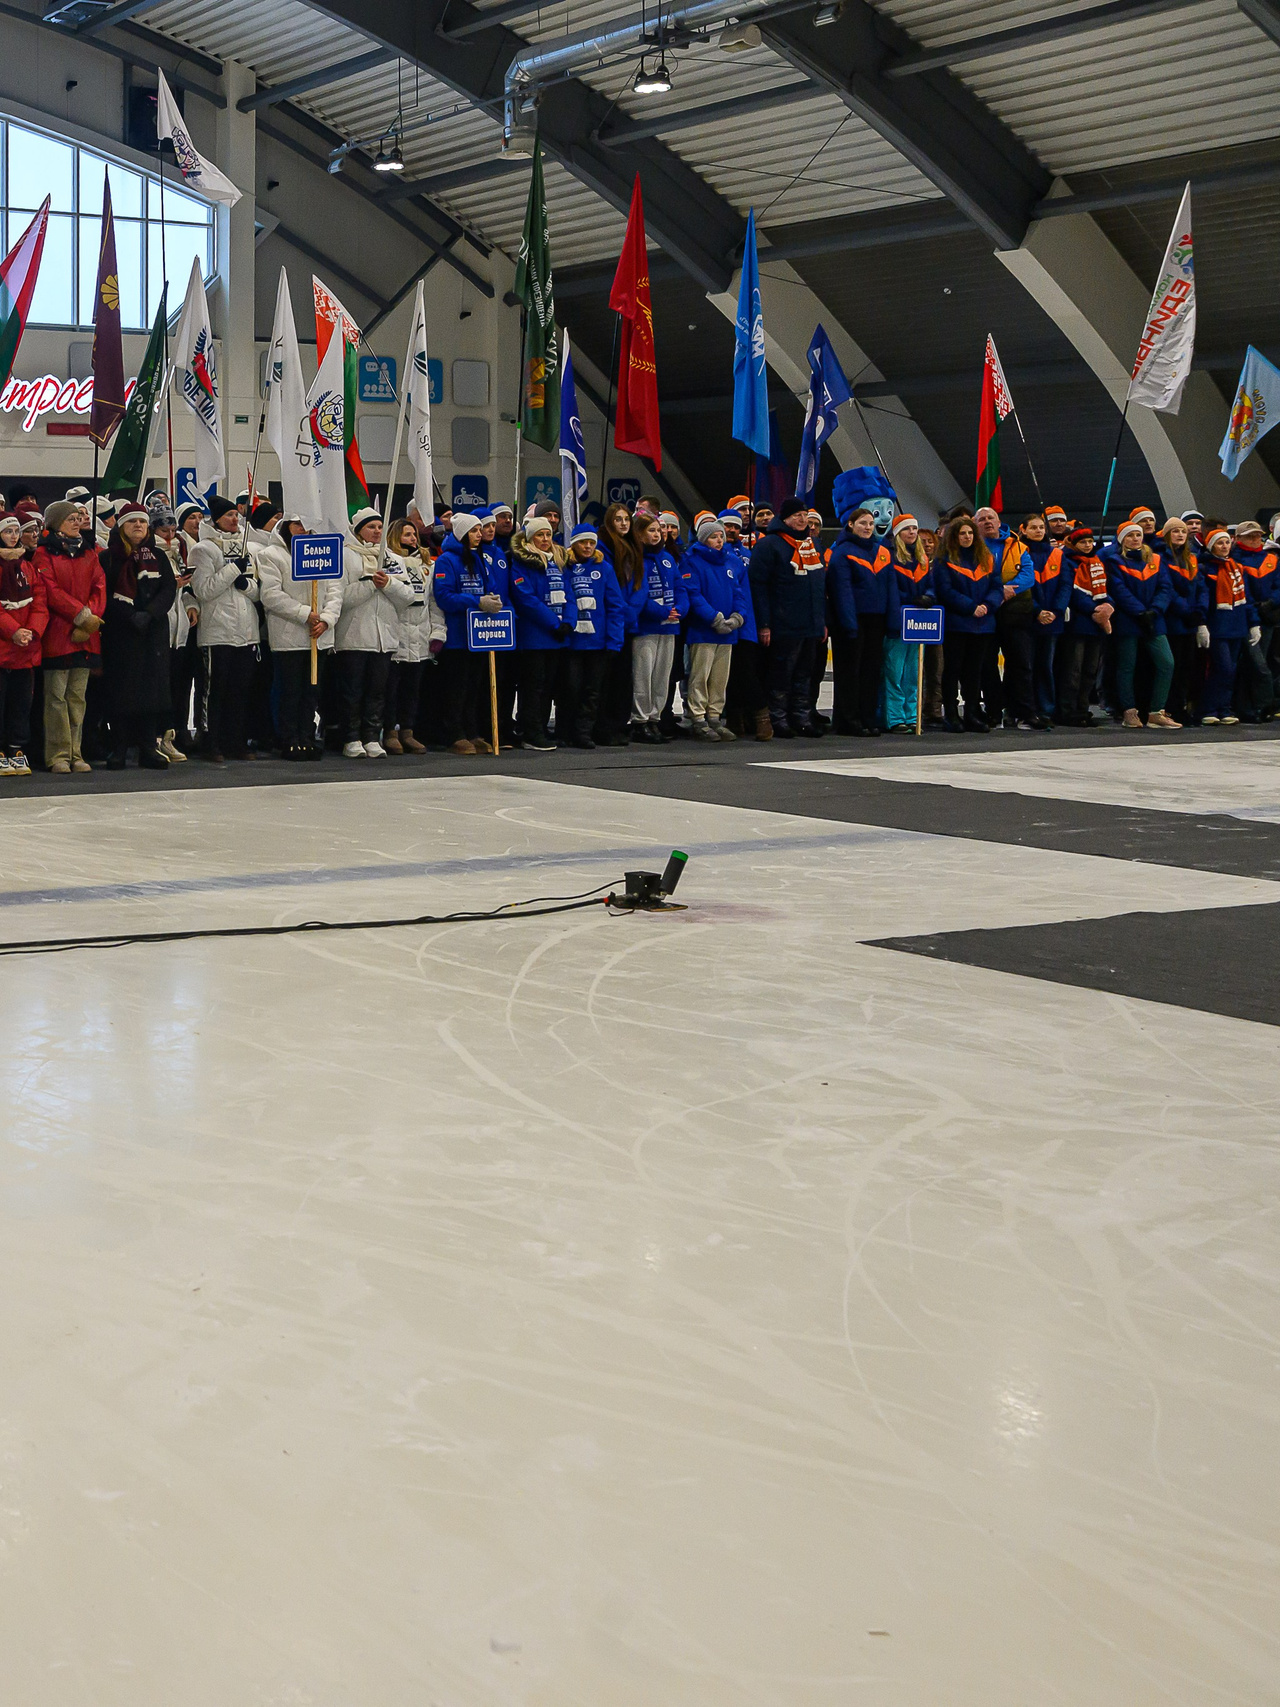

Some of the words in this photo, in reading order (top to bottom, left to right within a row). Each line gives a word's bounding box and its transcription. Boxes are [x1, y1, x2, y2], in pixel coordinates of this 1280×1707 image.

[303, 543, 331, 556] Белые
[302, 557, 332, 571] тигры
[473, 617, 509, 629] Академия
[907, 619, 938, 631] Молния
[477, 629, 506, 641] сервиса
